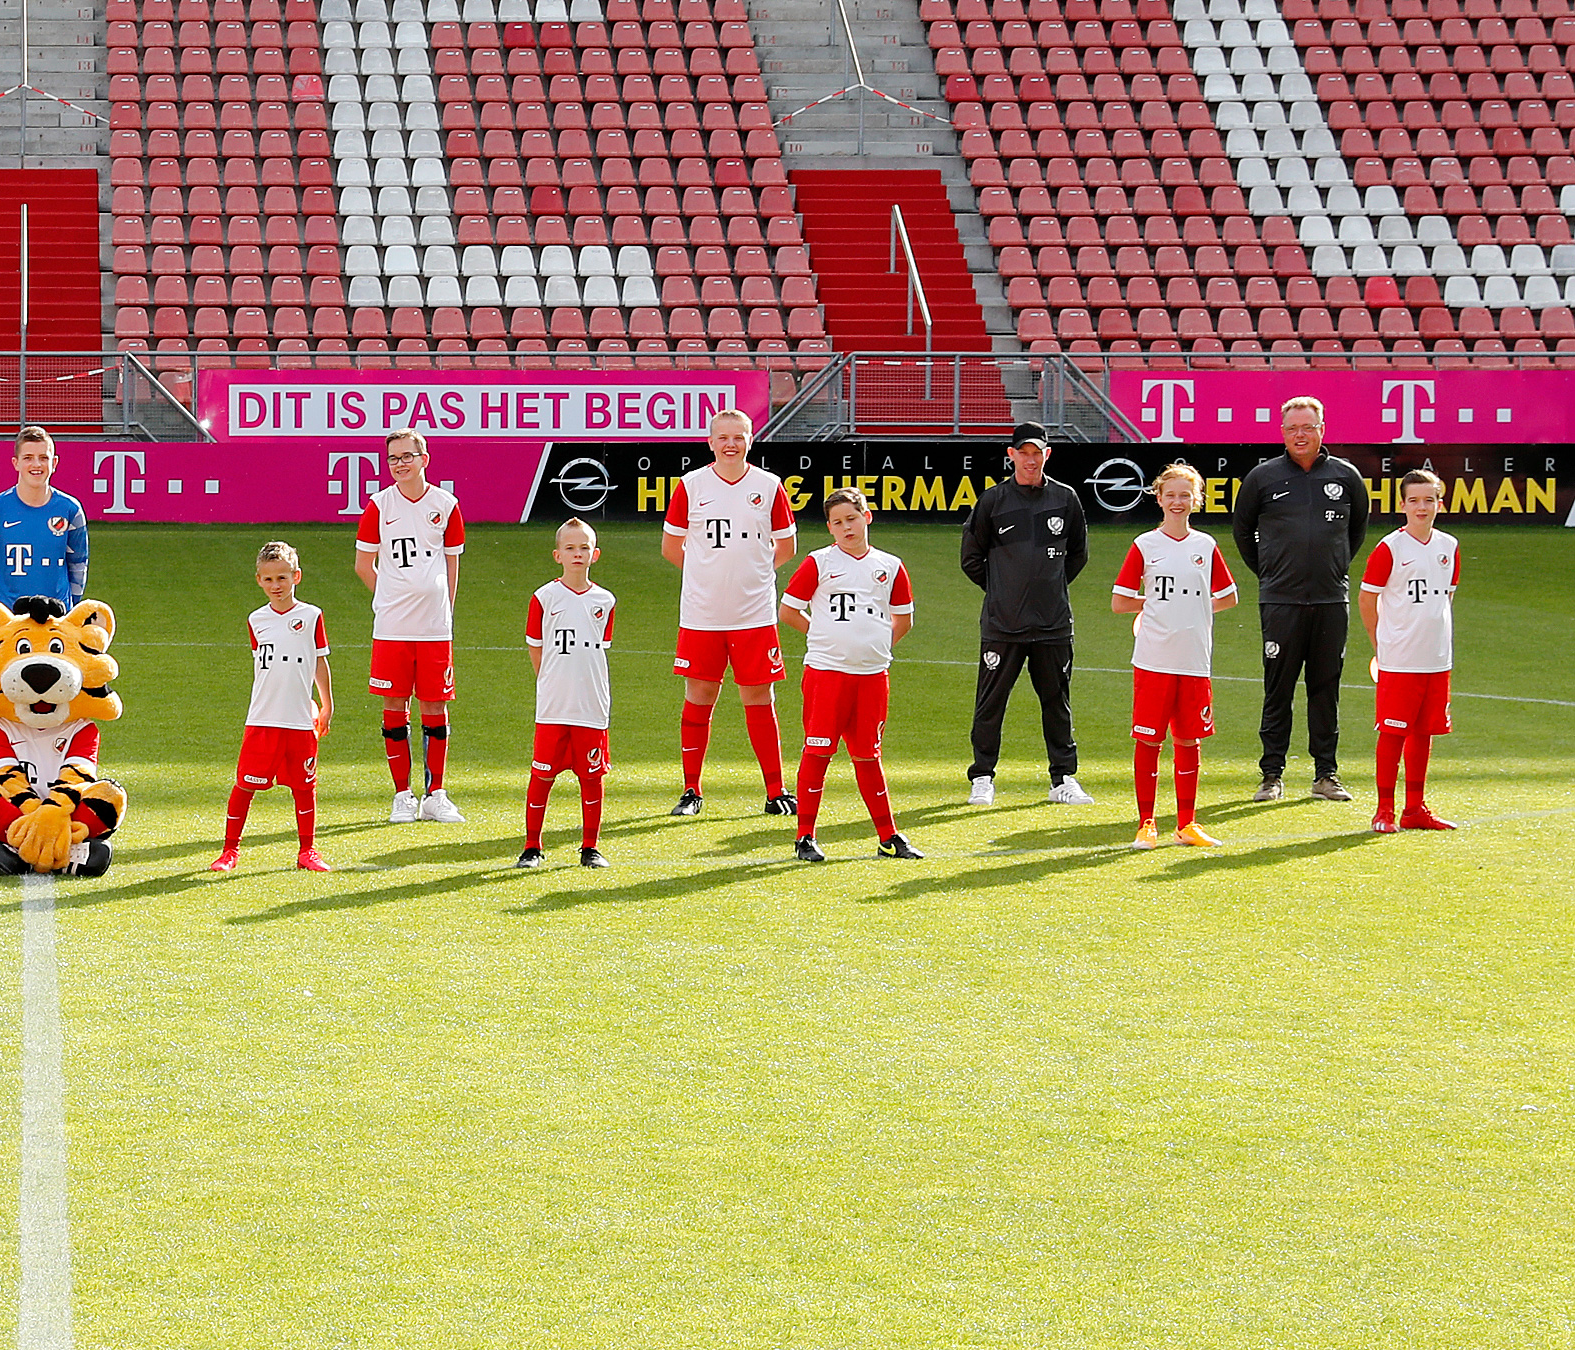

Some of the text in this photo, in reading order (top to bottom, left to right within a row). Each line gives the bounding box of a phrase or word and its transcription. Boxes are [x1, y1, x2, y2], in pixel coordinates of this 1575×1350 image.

[77, 61, 91, 70] 13
[789, 143, 802, 153] 10
[239, 392, 725, 429] DIT IS PAS HET BEGIN
